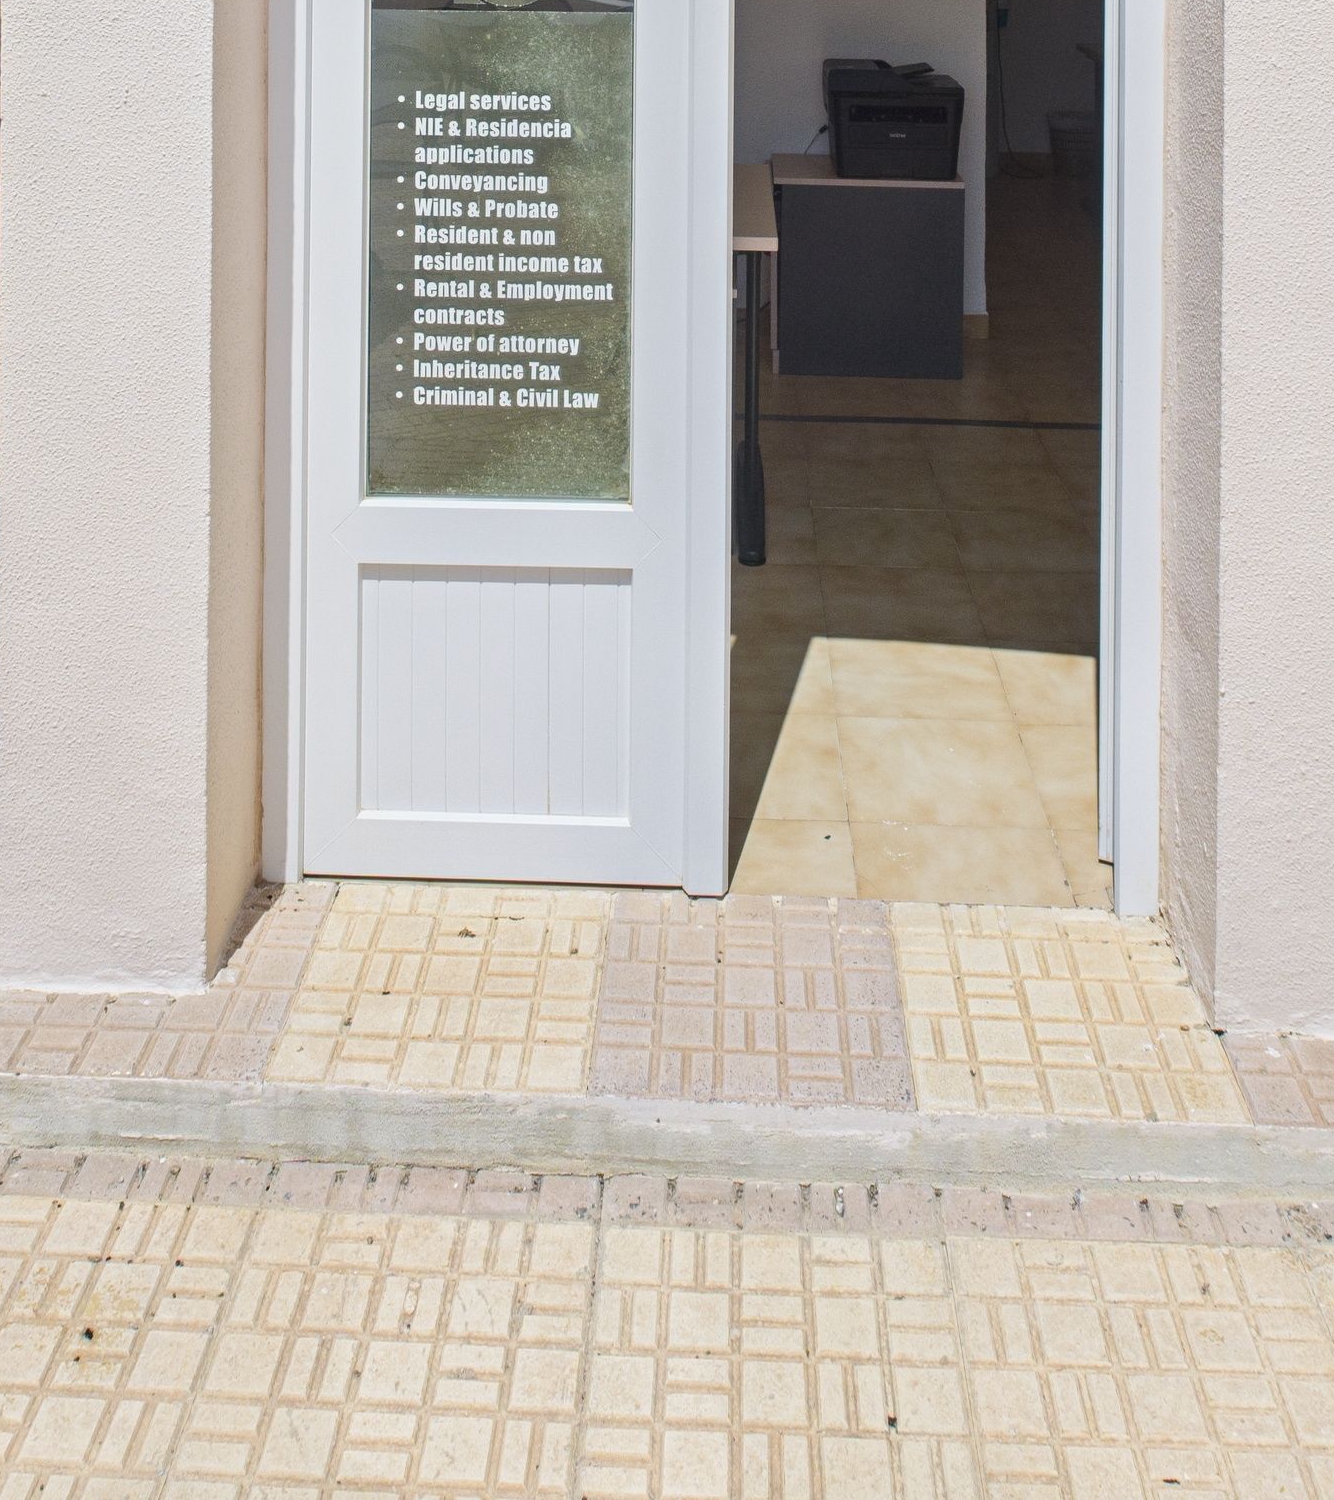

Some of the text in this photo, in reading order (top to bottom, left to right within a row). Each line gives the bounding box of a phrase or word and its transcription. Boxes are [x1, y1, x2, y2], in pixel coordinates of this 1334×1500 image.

[415, 90, 552, 111] Legal services
[415, 117, 572, 138] NIE & Residencia
[414, 144, 534, 164] applications
[414, 170, 548, 194] Conveyancing
[414, 197, 559, 219] Wills & Probate
[414, 225, 556, 246] Resident & non
[414, 252, 603, 274] resident income tax
[414, 278, 614, 302] Rental & Employment
[413, 307, 505, 325] contracts
[413, 332, 580, 356] Power of attorney
[413, 359, 561, 381] Inheritance Tax
[413, 386, 599, 408] Criminal & Civil Law
